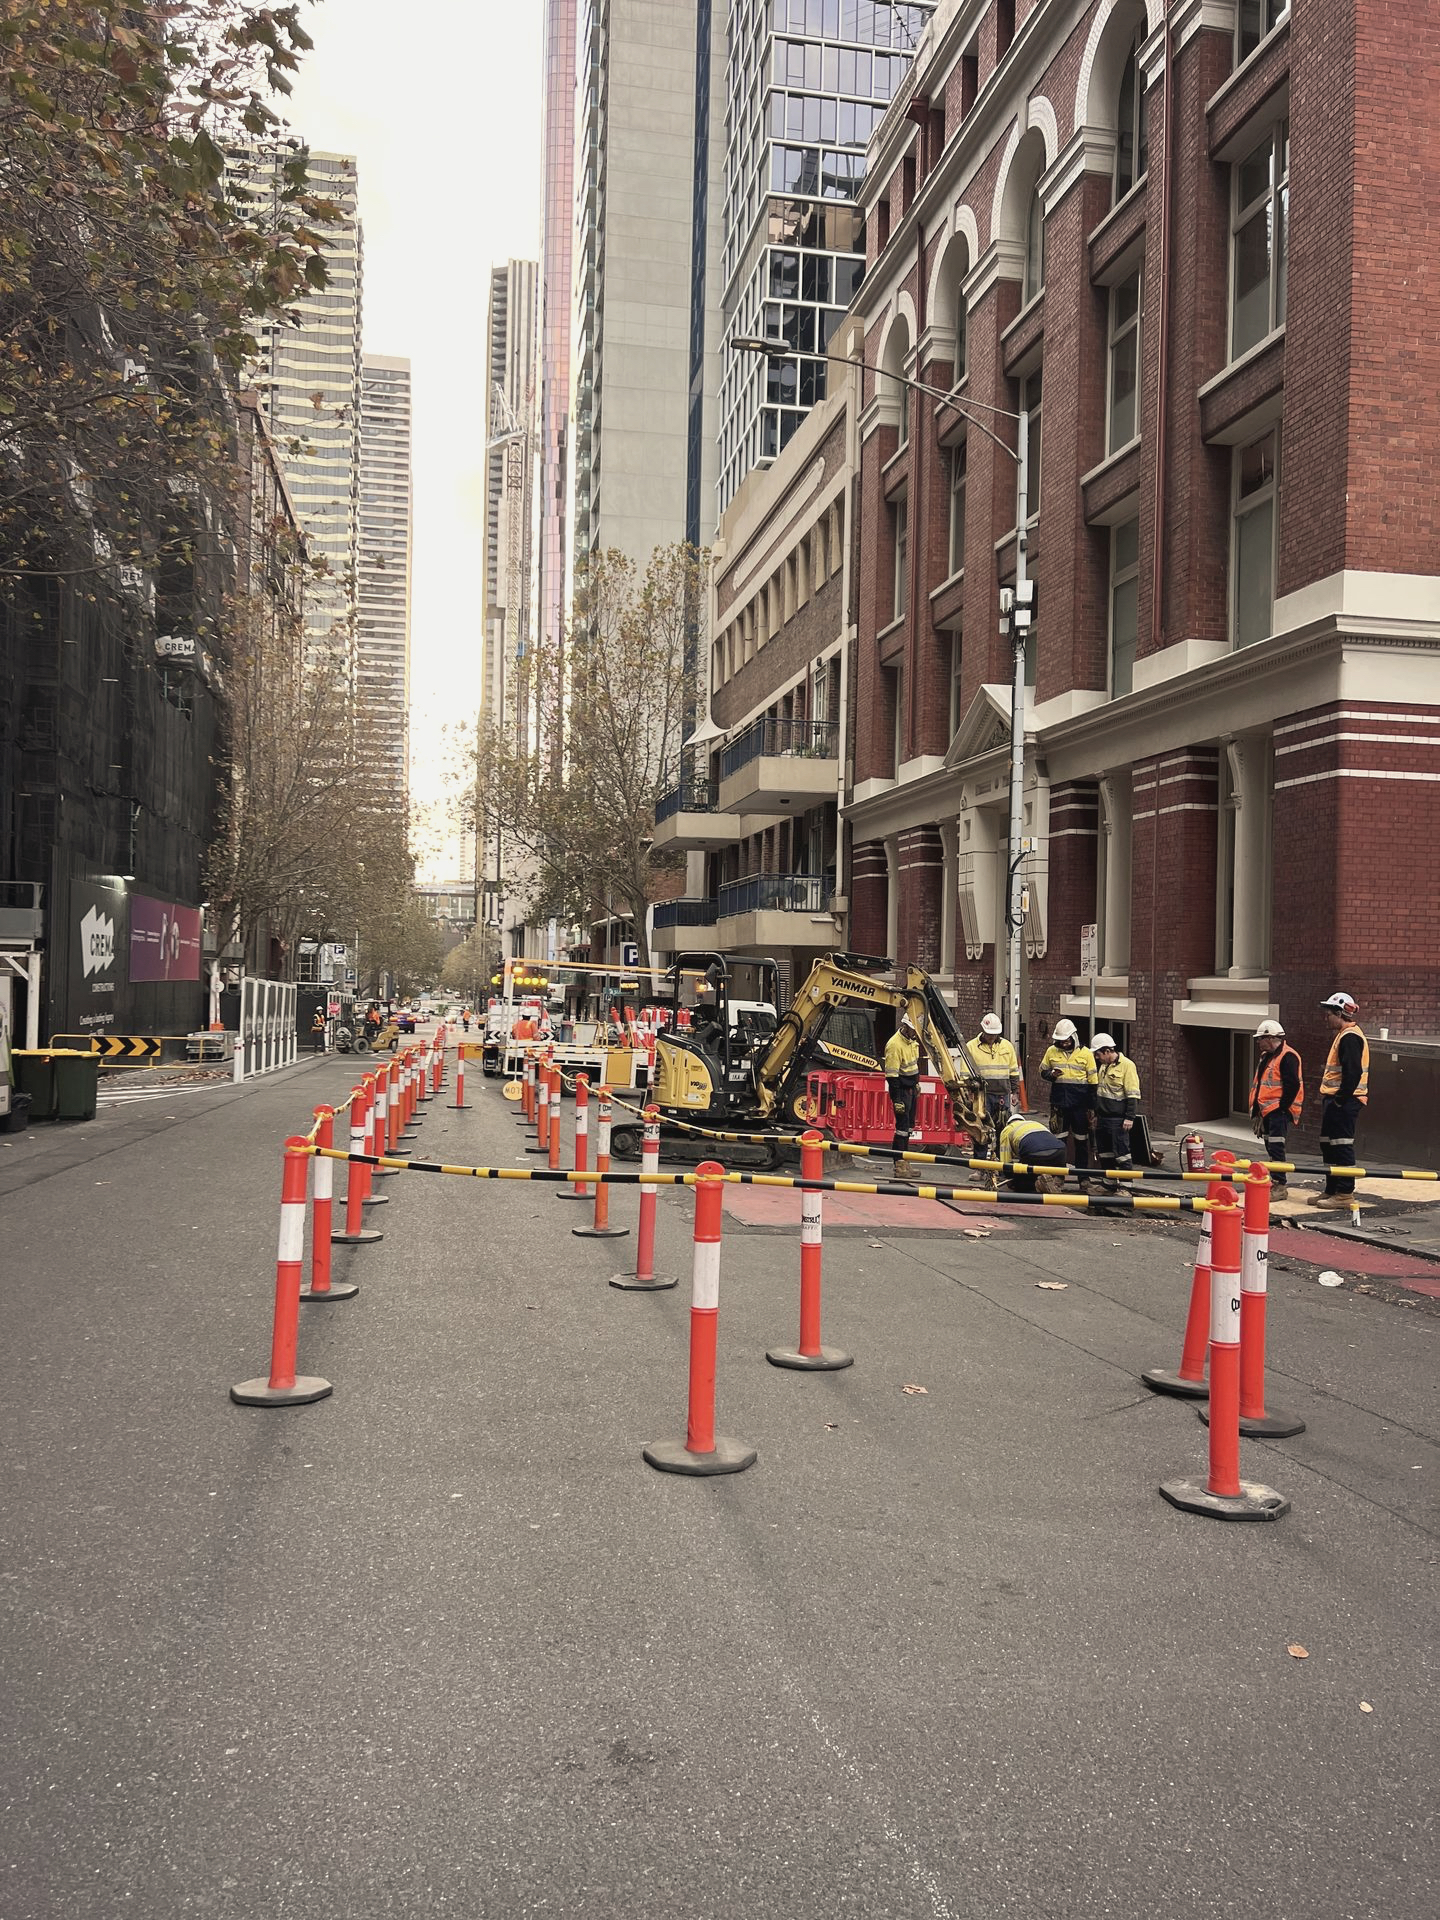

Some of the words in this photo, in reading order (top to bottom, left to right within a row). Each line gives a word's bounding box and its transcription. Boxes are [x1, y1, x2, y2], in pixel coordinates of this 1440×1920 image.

[629, 948, 639, 963] P
[831, 976, 876, 997] YANMAR
[832, 1047, 847, 1057] NEW
[847, 1052, 875, 1066] HOLLAND
